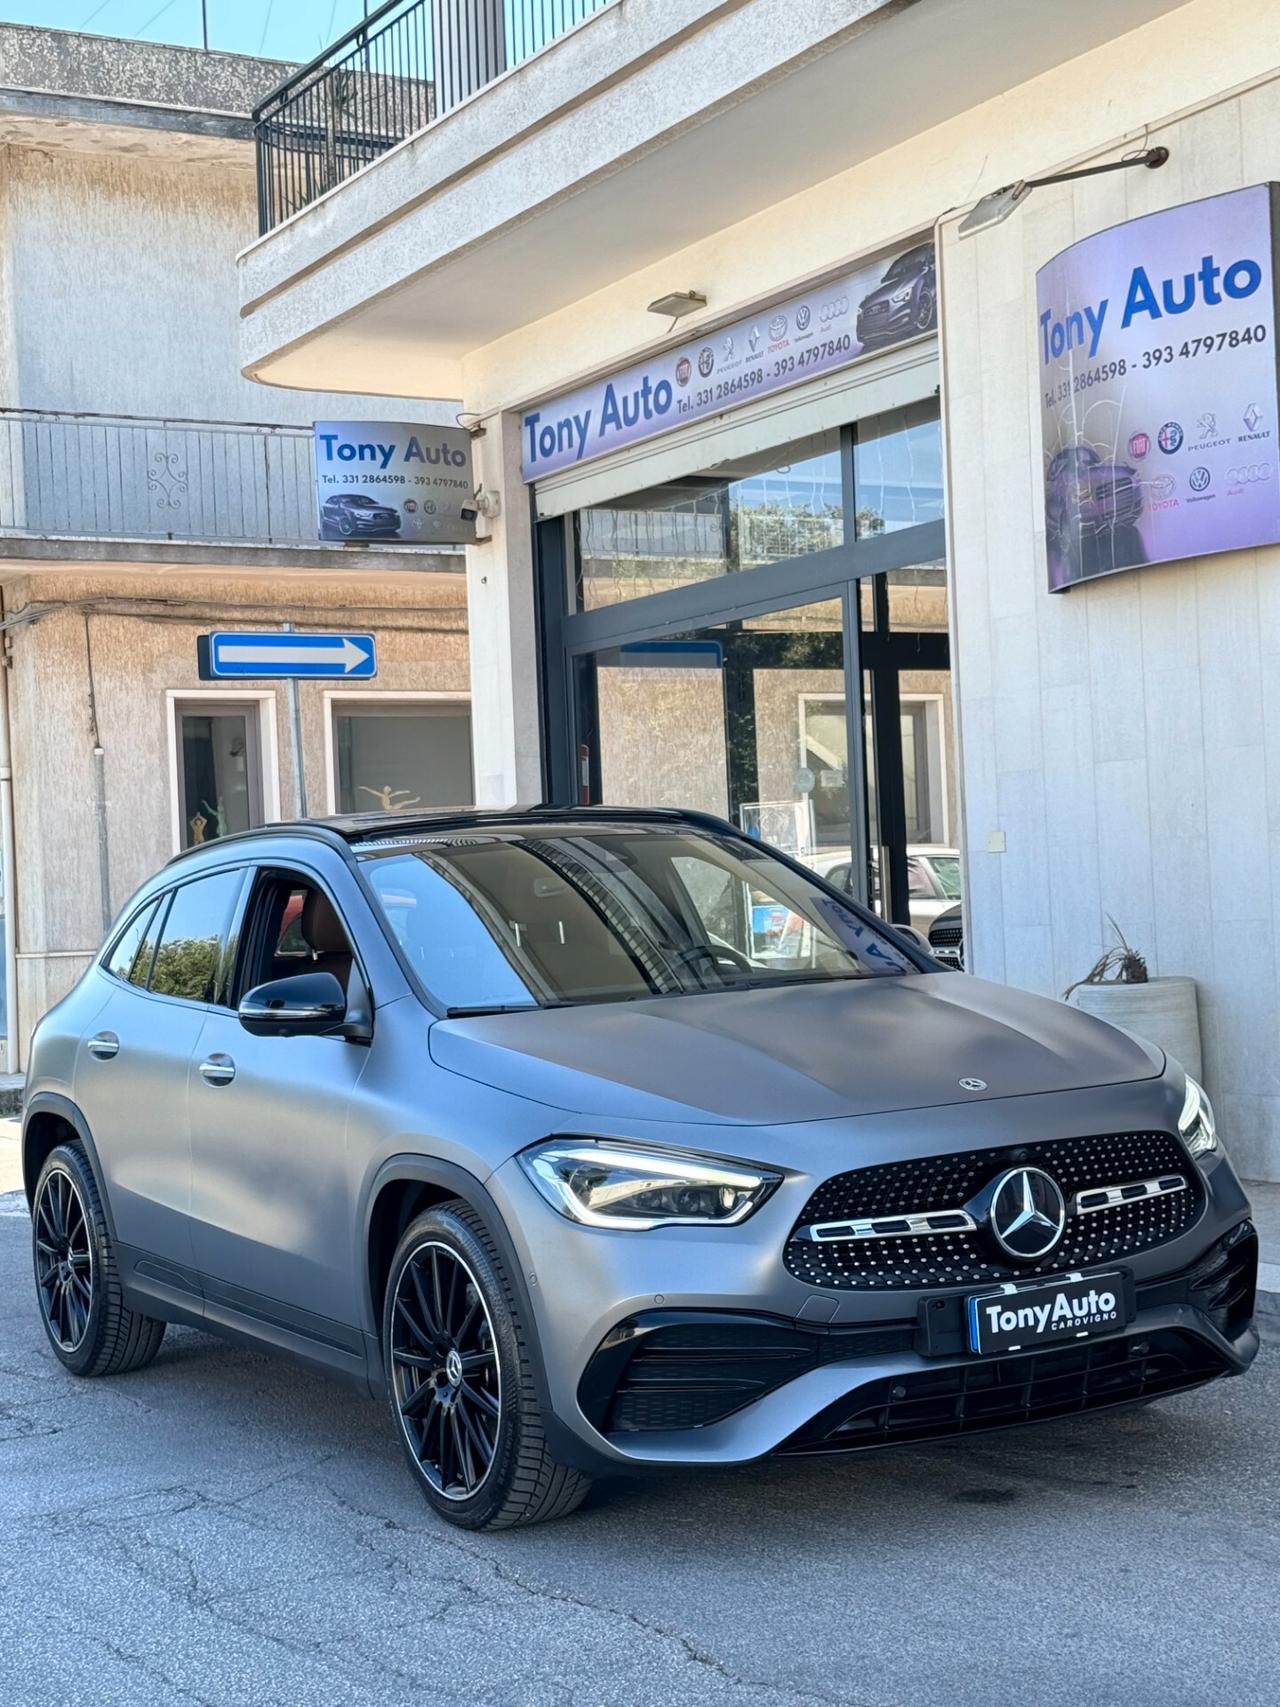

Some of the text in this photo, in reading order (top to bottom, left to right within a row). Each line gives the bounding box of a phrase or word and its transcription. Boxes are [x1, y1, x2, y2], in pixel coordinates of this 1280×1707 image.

[1040, 255, 1262, 366] Tony Auto
[677, 399, 694, 415] Tel.
[696, 387, 715, 409] 331
[716, 362, 763, 402] 2864598
[774, 356, 795, 377] 393
[797, 334, 851, 368] 4797840
[1073, 359, 1127, 393] 2864598
[1142, 345, 1174, 370] 393
[1179, 324, 1267, 361] 4797840
[524, 375, 673, 462] Tony Auto
[320, 434, 466, 469] Tony Auto
[1187, 438, 1231, 452] PEUGEOT
[1238, 431, 1270, 442] RENAULT
[322, 475, 339, 484] Tel.
[342, 475, 359, 484] 331
[362, 475, 405, 485] 2864598
[414, 476, 431, 486] 393
[433, 478, 469, 490] 4797840
[1051, 1311, 1117, 1331] CAROVIGNO
